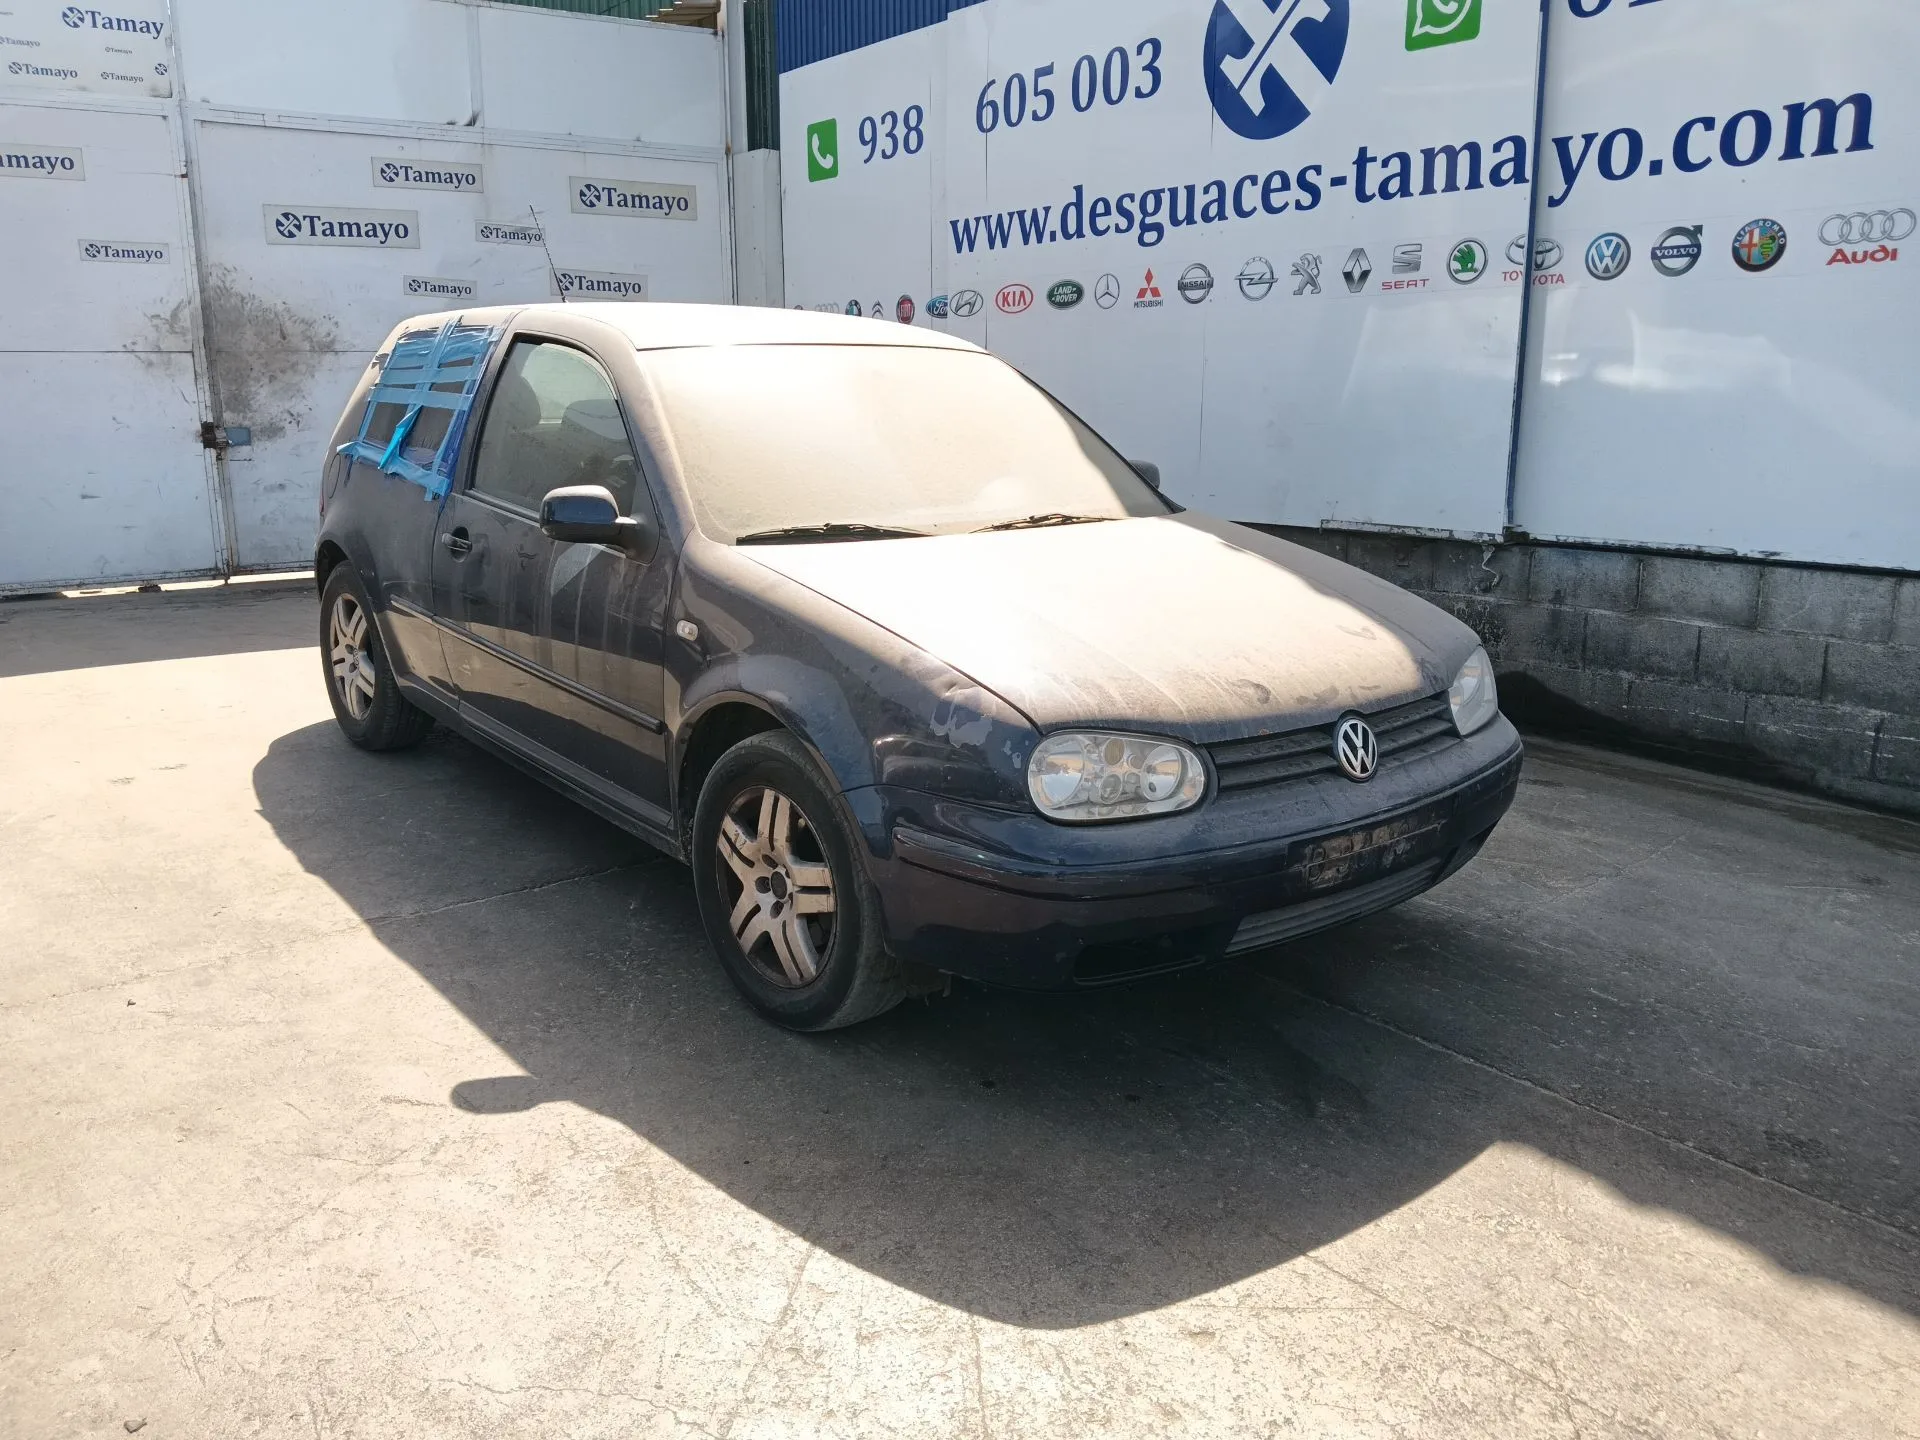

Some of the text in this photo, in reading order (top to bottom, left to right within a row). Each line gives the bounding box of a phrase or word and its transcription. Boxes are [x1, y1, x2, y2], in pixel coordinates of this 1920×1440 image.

[85, 10, 164, 40] Tamay
[5, 36, 41, 48] Tamayo
[22, 63, 78, 80] Tamayo
[109, 72, 144, 83] Tamayo
[858, 37, 1162, 165] 938 605 003
[0, 153, 75, 175] mayo
[400, 165, 476, 188] Tamayo
[950, 93, 1874, 254] www.desguaces-tamayo.com
[602, 187, 689, 216] Tamayo
[303, 215, 409, 244] Tamayo
[493, 227, 541, 243] Tamayo
[1734, 220, 1786, 249] ALFA ROMEO
[101, 245, 164, 262] Tamayo
[1655, 246, 1698, 258] VOLVO
[1825, 244, 1898, 266] Audi
[421, 281, 472, 296] Tamayo
[574, 275, 642, 296] Tamayo
[1053, 286, 1072, 295] LAND
[1381, 278, 1430, 291] SEAT
[1001, 291, 1028, 308] KIA
[1055, 294, 1078, 304] ROVER
[1133, 300, 1164, 309] MITSUBISHI
